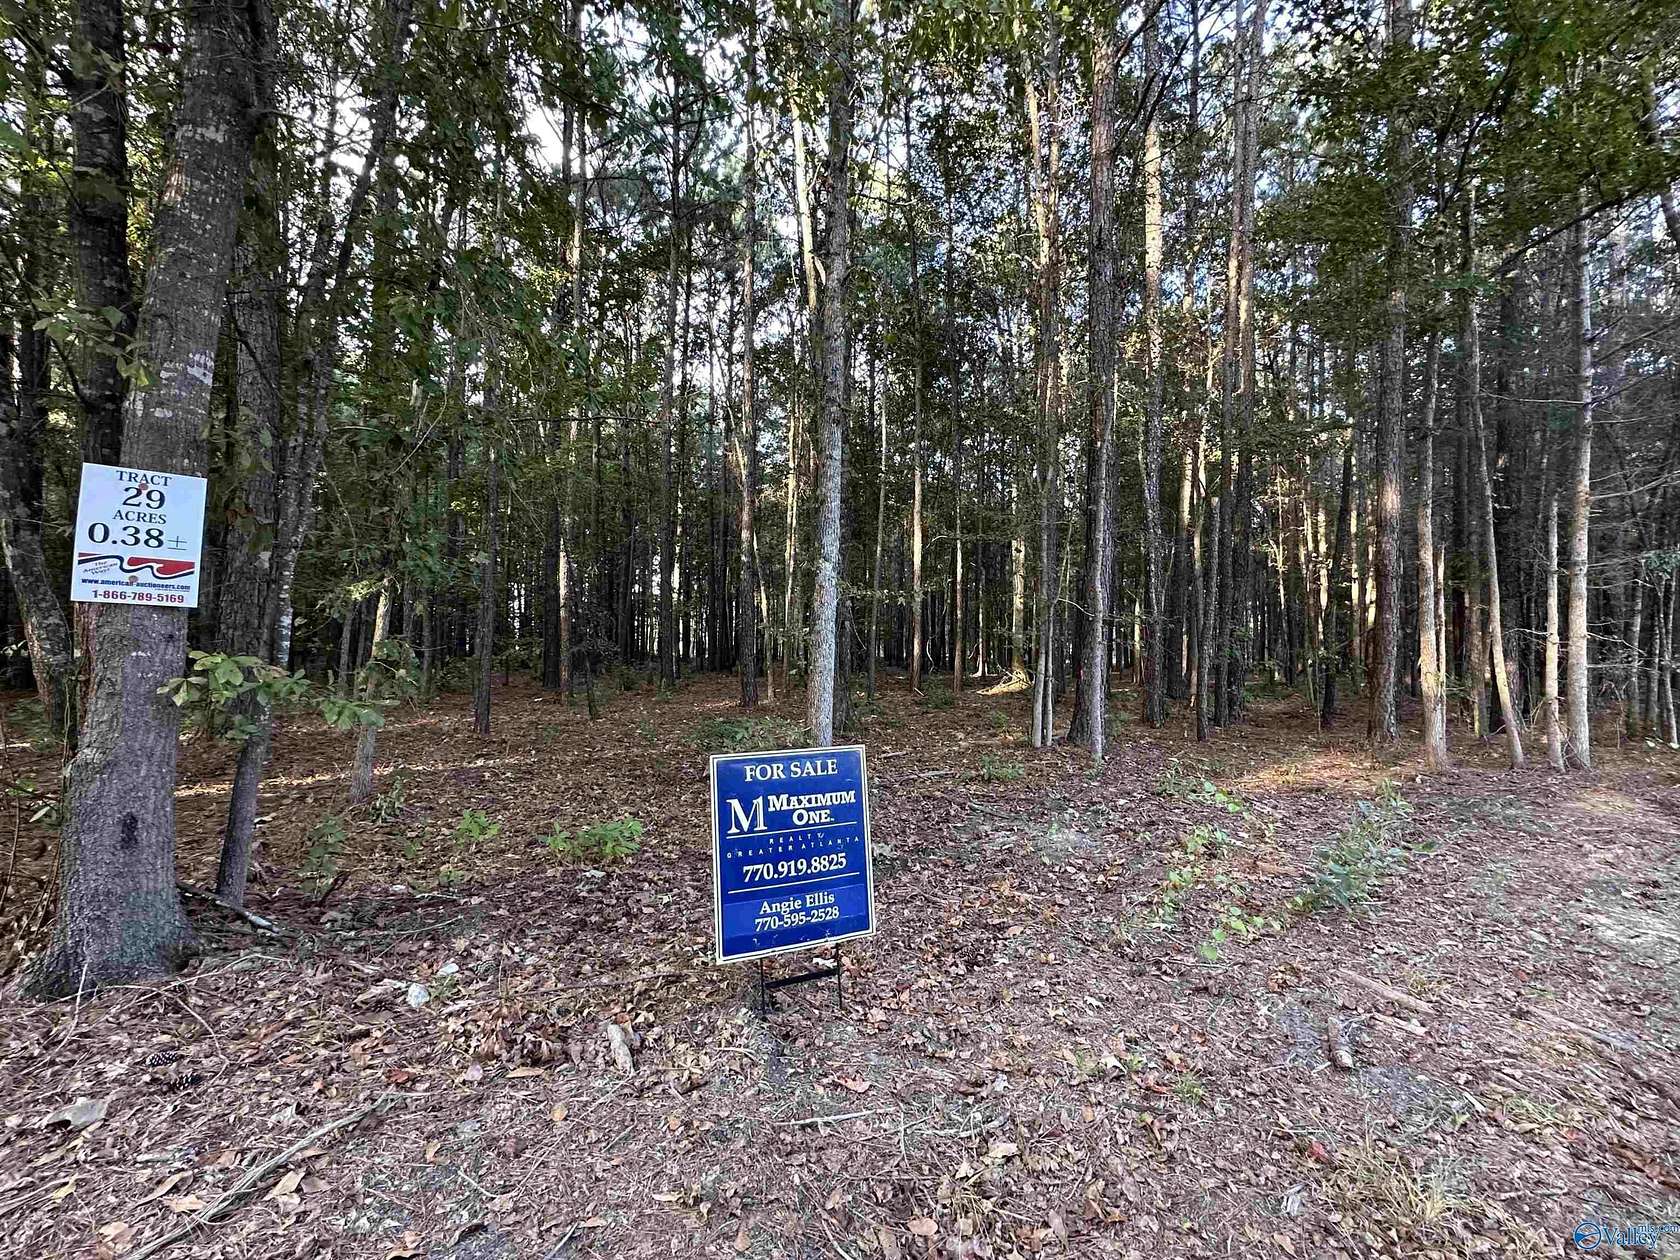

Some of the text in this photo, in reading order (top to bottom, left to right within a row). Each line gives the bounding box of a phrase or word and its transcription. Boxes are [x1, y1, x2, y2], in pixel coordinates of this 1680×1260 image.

[116, 470, 172, 486] TRACT
[122, 487, 166, 509] 29
[112, 509, 167, 524] ACRES
[81, 578, 191, 591] www.american-auctioneers.com
[92, 590, 184, 603] 1-866-789-5169
[744, 759, 838, 782] FOR SALE
[768, 790, 856, 811] MAXIMUM
[726, 795, 768, 834] M
[726, 836, 859, 859] GREATER ATLANTA
[769, 832, 823, 845] REALTY
[743, 853, 847, 882] 770.919.8825
[759, 891, 835, 915] Angie Ellis
[755, 906, 840, 932] 770-595-2528
